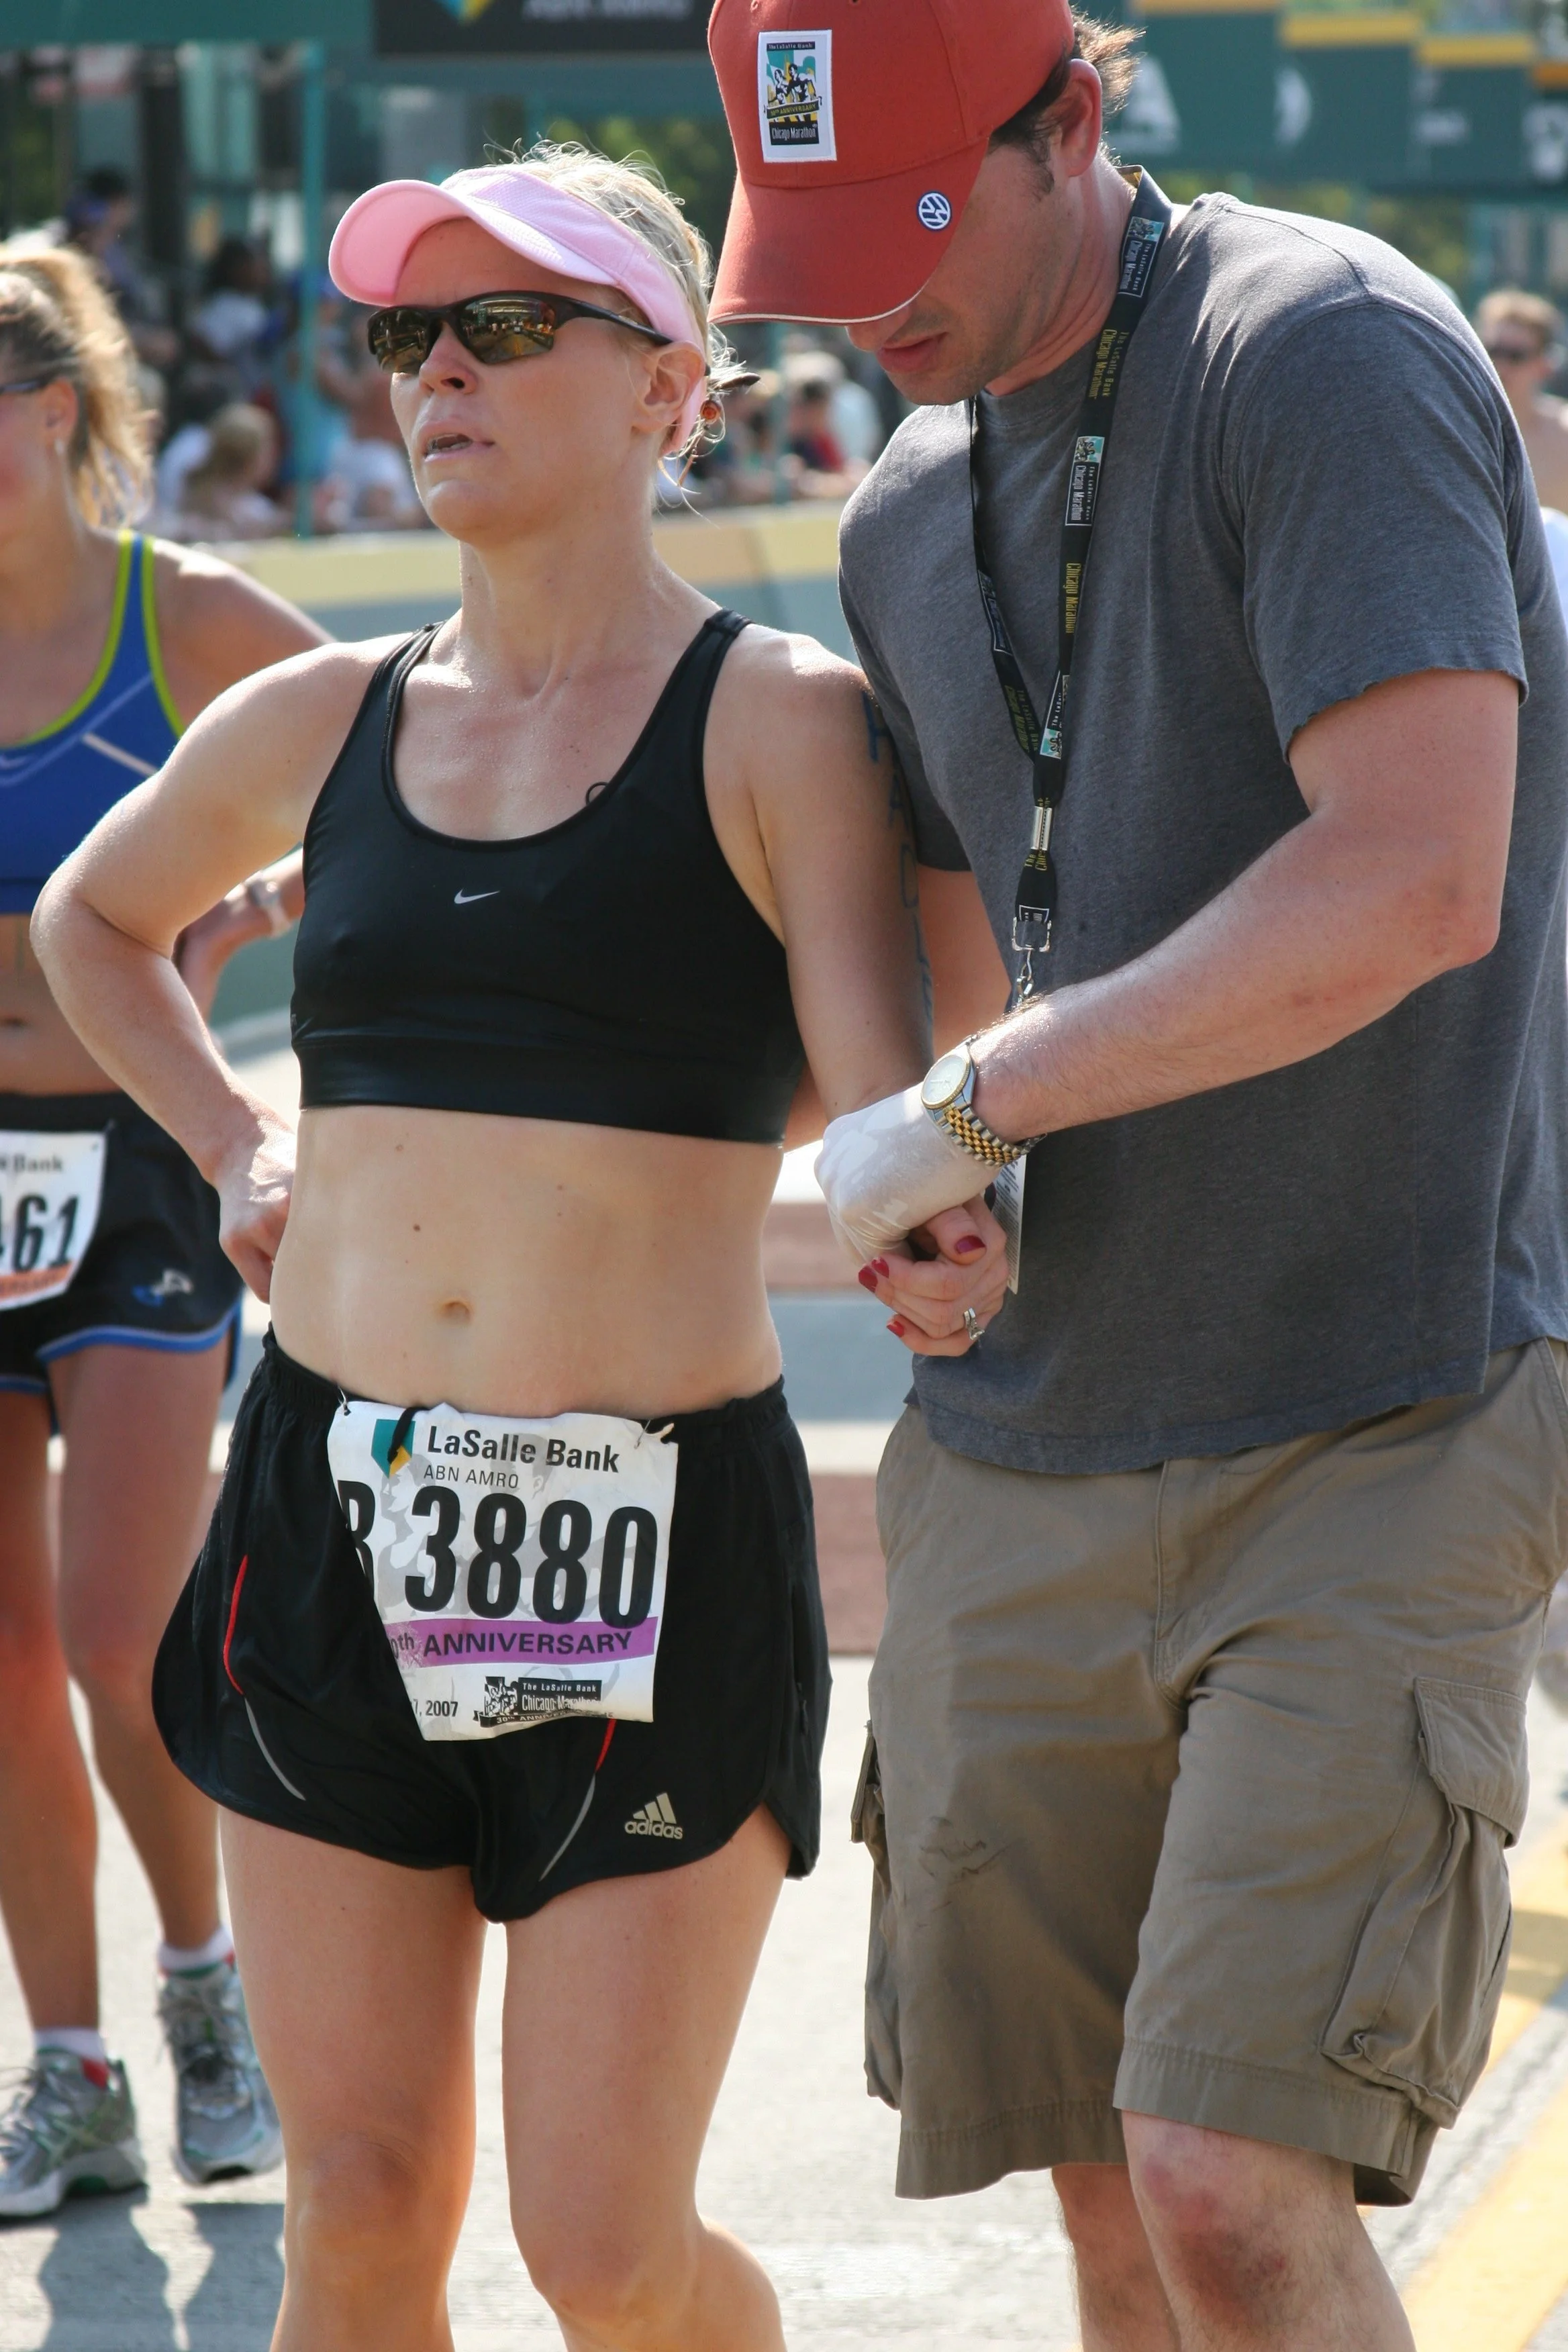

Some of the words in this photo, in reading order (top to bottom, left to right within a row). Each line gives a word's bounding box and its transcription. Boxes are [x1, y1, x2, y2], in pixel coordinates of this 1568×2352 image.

[771, 127, 790, 141] Chicago
[1095, 329, 1118, 359] Chicago
[1117, 331, 1130, 344] The
[1101, 379, 1114, 397] Bank
[1072, 464, 1087, 490] Chicago
[1071, 491, 1085, 520] Marathon
[1063, 562, 1081, 594] Chicago
[1065, 596, 1079, 634] Marathon
[13, 1155, 64, 1173] Bank
[0, 1194, 79, 1273] 61
[428, 1426, 536, 1464] LaSalle
[546, 1438, 620, 1473] Bank
[424, 1464, 459, 1482] ABN
[466, 1470, 519, 1489] AMRO
[405, 1485, 658, 1629] 3880
[423, 1631, 633, 1657] ANNIVERSARY
[523, 1683, 537, 1691] The
[541, 1683, 572, 1692] LaSalle
[576, 1685, 597, 1693] Bank
[426, 1700, 458, 1717] 2007
[522, 1694, 554, 1713] Chicago
[624, 1818, 683, 1840] adidas
